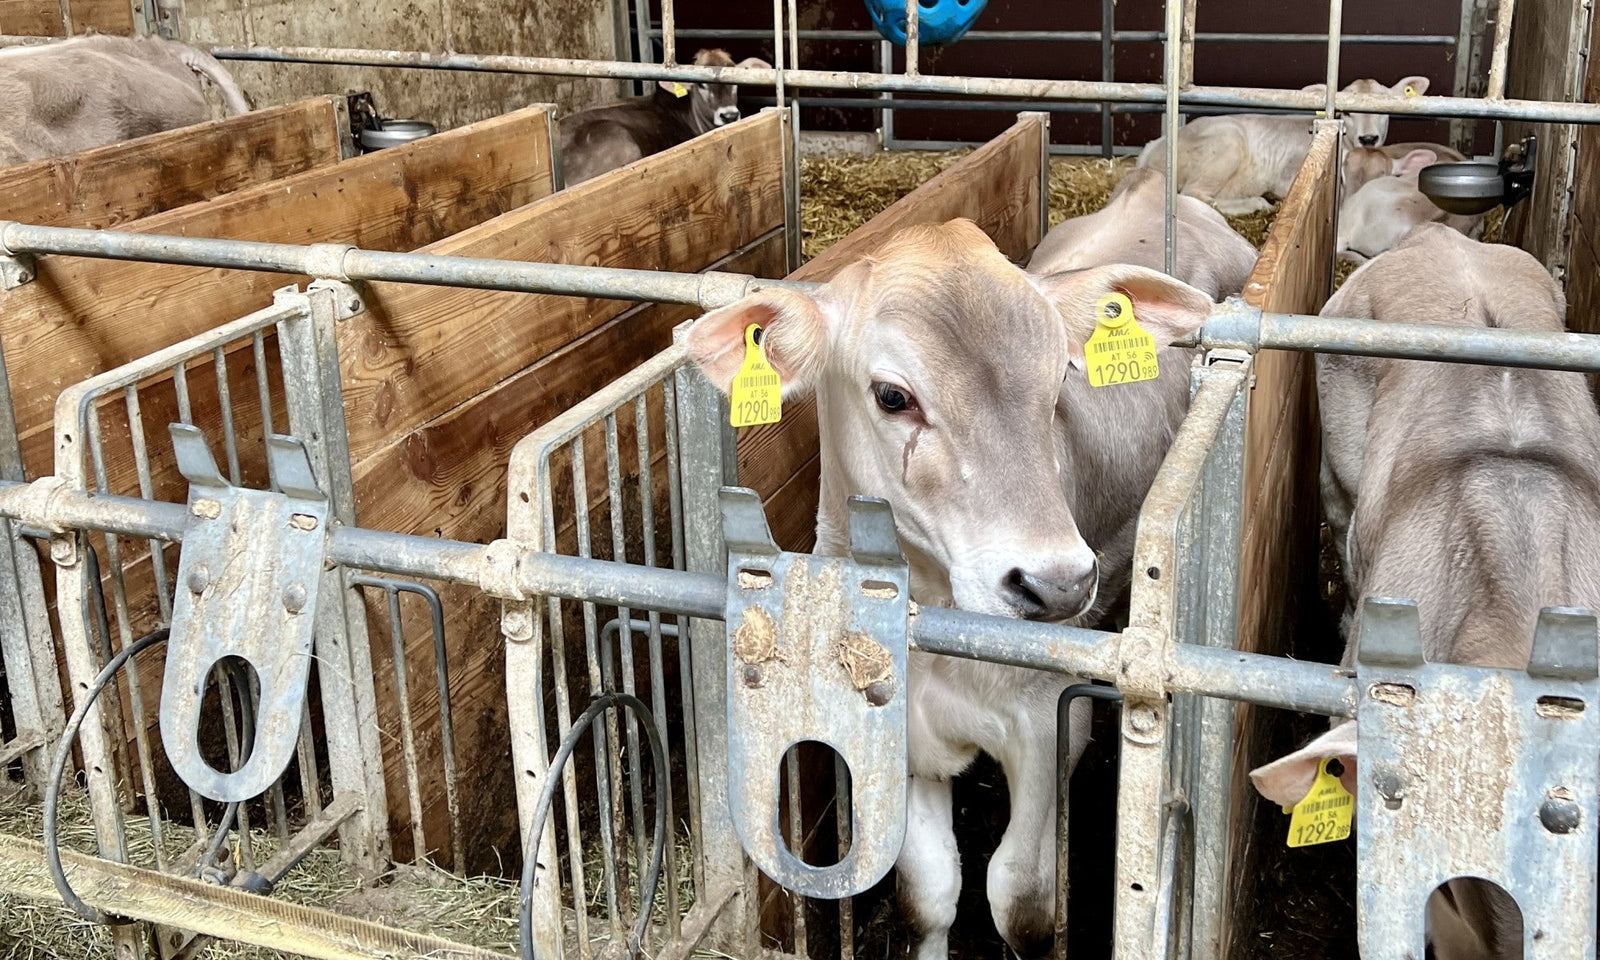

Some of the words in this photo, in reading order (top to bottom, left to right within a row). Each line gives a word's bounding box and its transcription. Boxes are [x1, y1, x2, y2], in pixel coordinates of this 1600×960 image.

[1111, 352, 1121, 361] AT
[1126, 351, 1137, 359] 56
[1096, 361, 1140, 385] 1290
[1142, 365, 1157, 378] 989
[750, 390, 758, 399] AT
[738, 400, 769, 424] 1290
[1297, 820, 1336, 844] 1292
